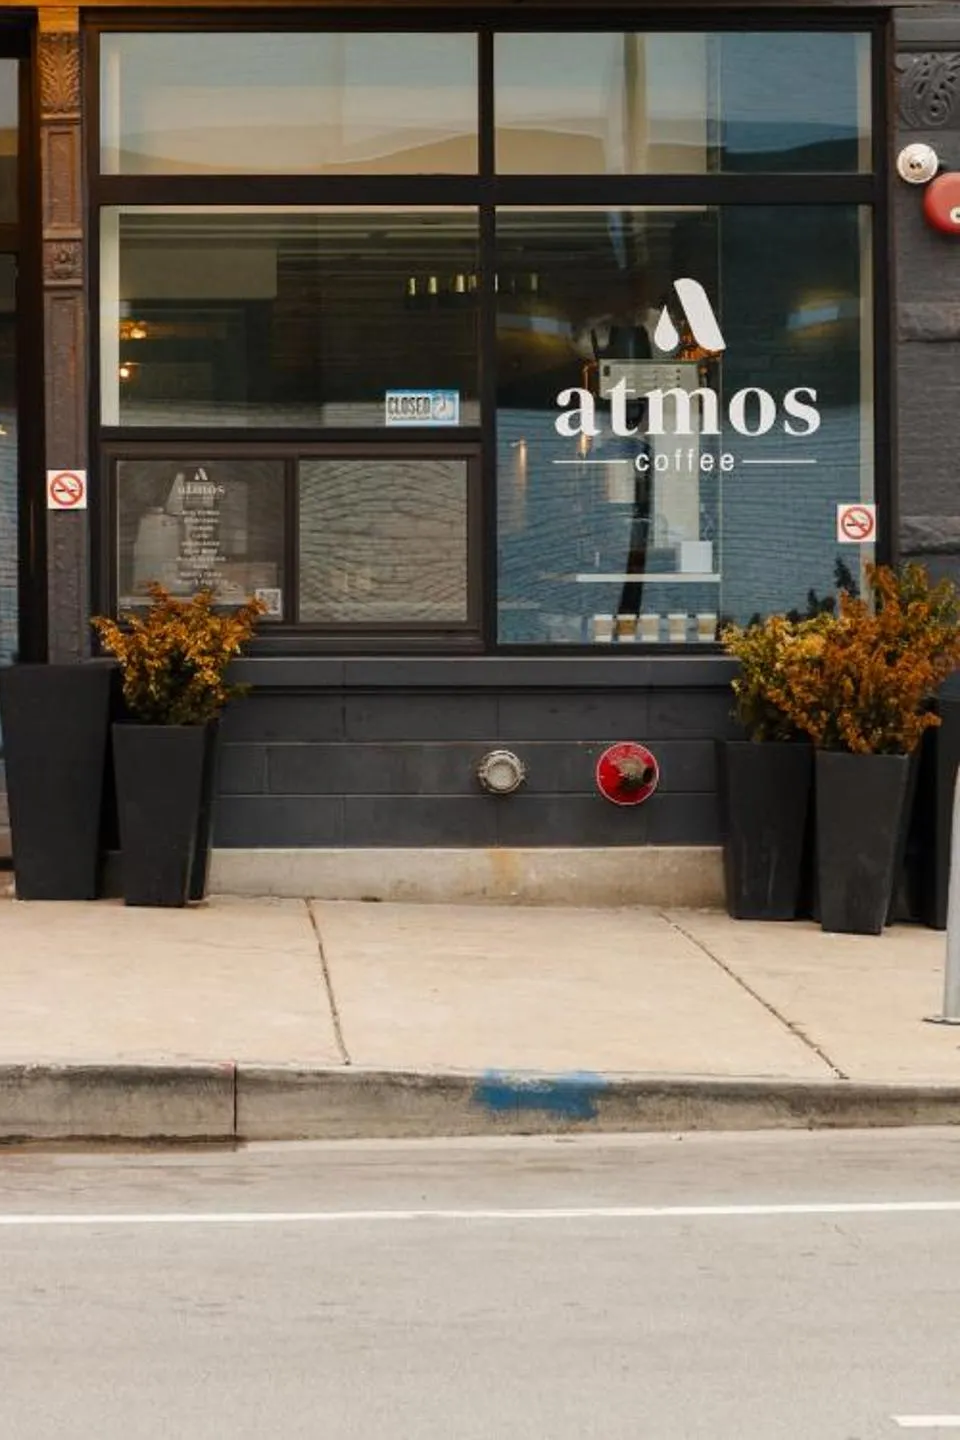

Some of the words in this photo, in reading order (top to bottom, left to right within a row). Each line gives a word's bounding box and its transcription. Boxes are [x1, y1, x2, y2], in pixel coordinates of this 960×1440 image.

[387, 396, 431, 415] CLOSED
[554, 376, 821, 437] atmos
[635, 448, 735, 471] coffee
